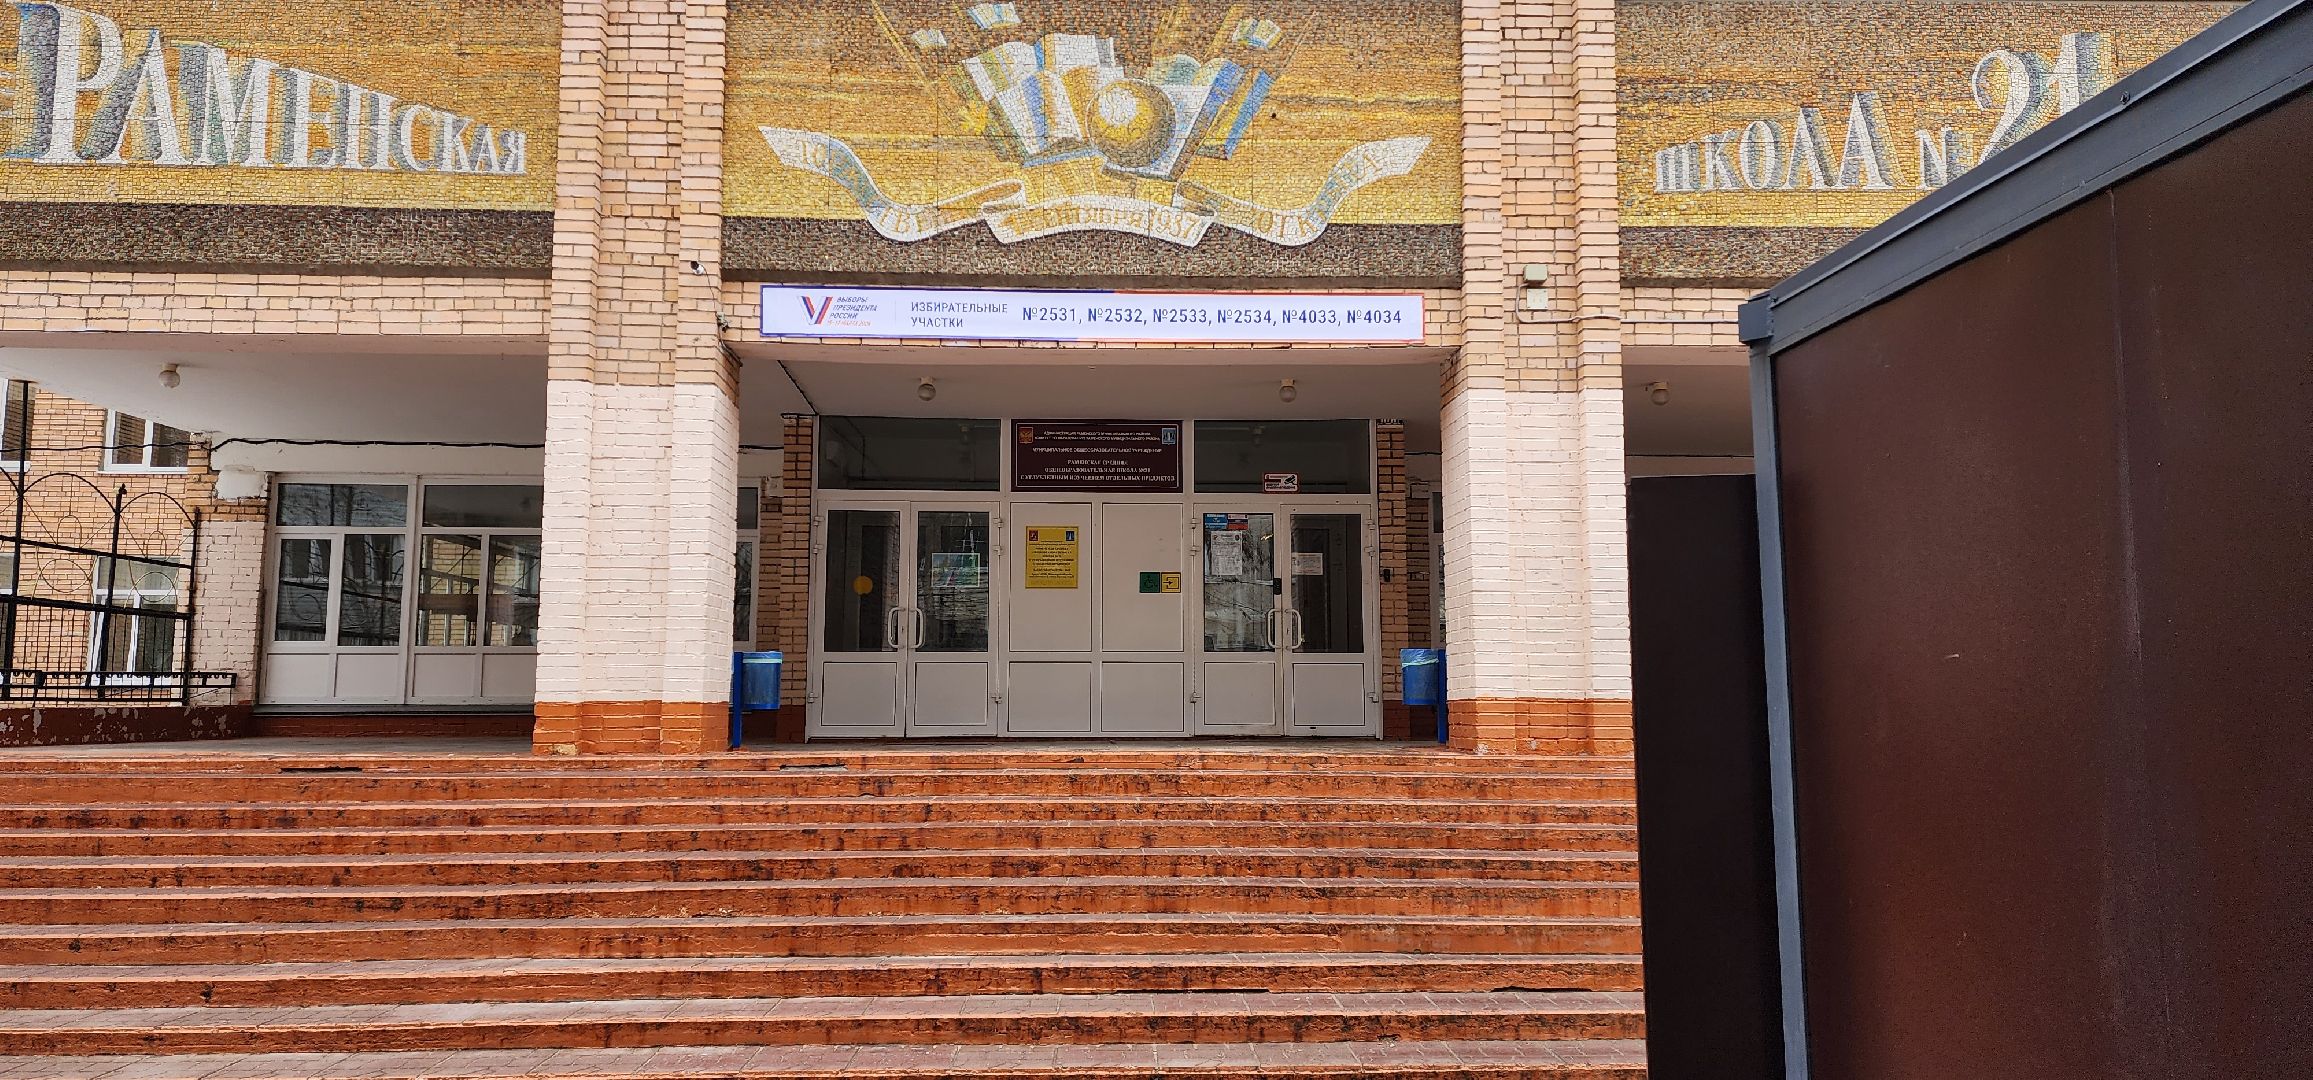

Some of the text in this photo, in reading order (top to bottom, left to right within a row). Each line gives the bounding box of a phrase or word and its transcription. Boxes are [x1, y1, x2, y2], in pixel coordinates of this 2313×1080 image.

[32, 0, 528, 175] РАМЕНСКАЯ
[1655, 92, 1902, 193] ШКОЛА
[1148, 207, 1199, 240] 1937
[832, 304, 878, 312] ПРЕЗИДЕНТА
[911, 301, 1008, 314] ИЗБИРАТЕЛЬНЫЕ
[1022, 307, 1402, 326] №2531, №2532, №2533, №2534, №4033, №4034
[910, 316, 964, 328] УЧАСТКИ
